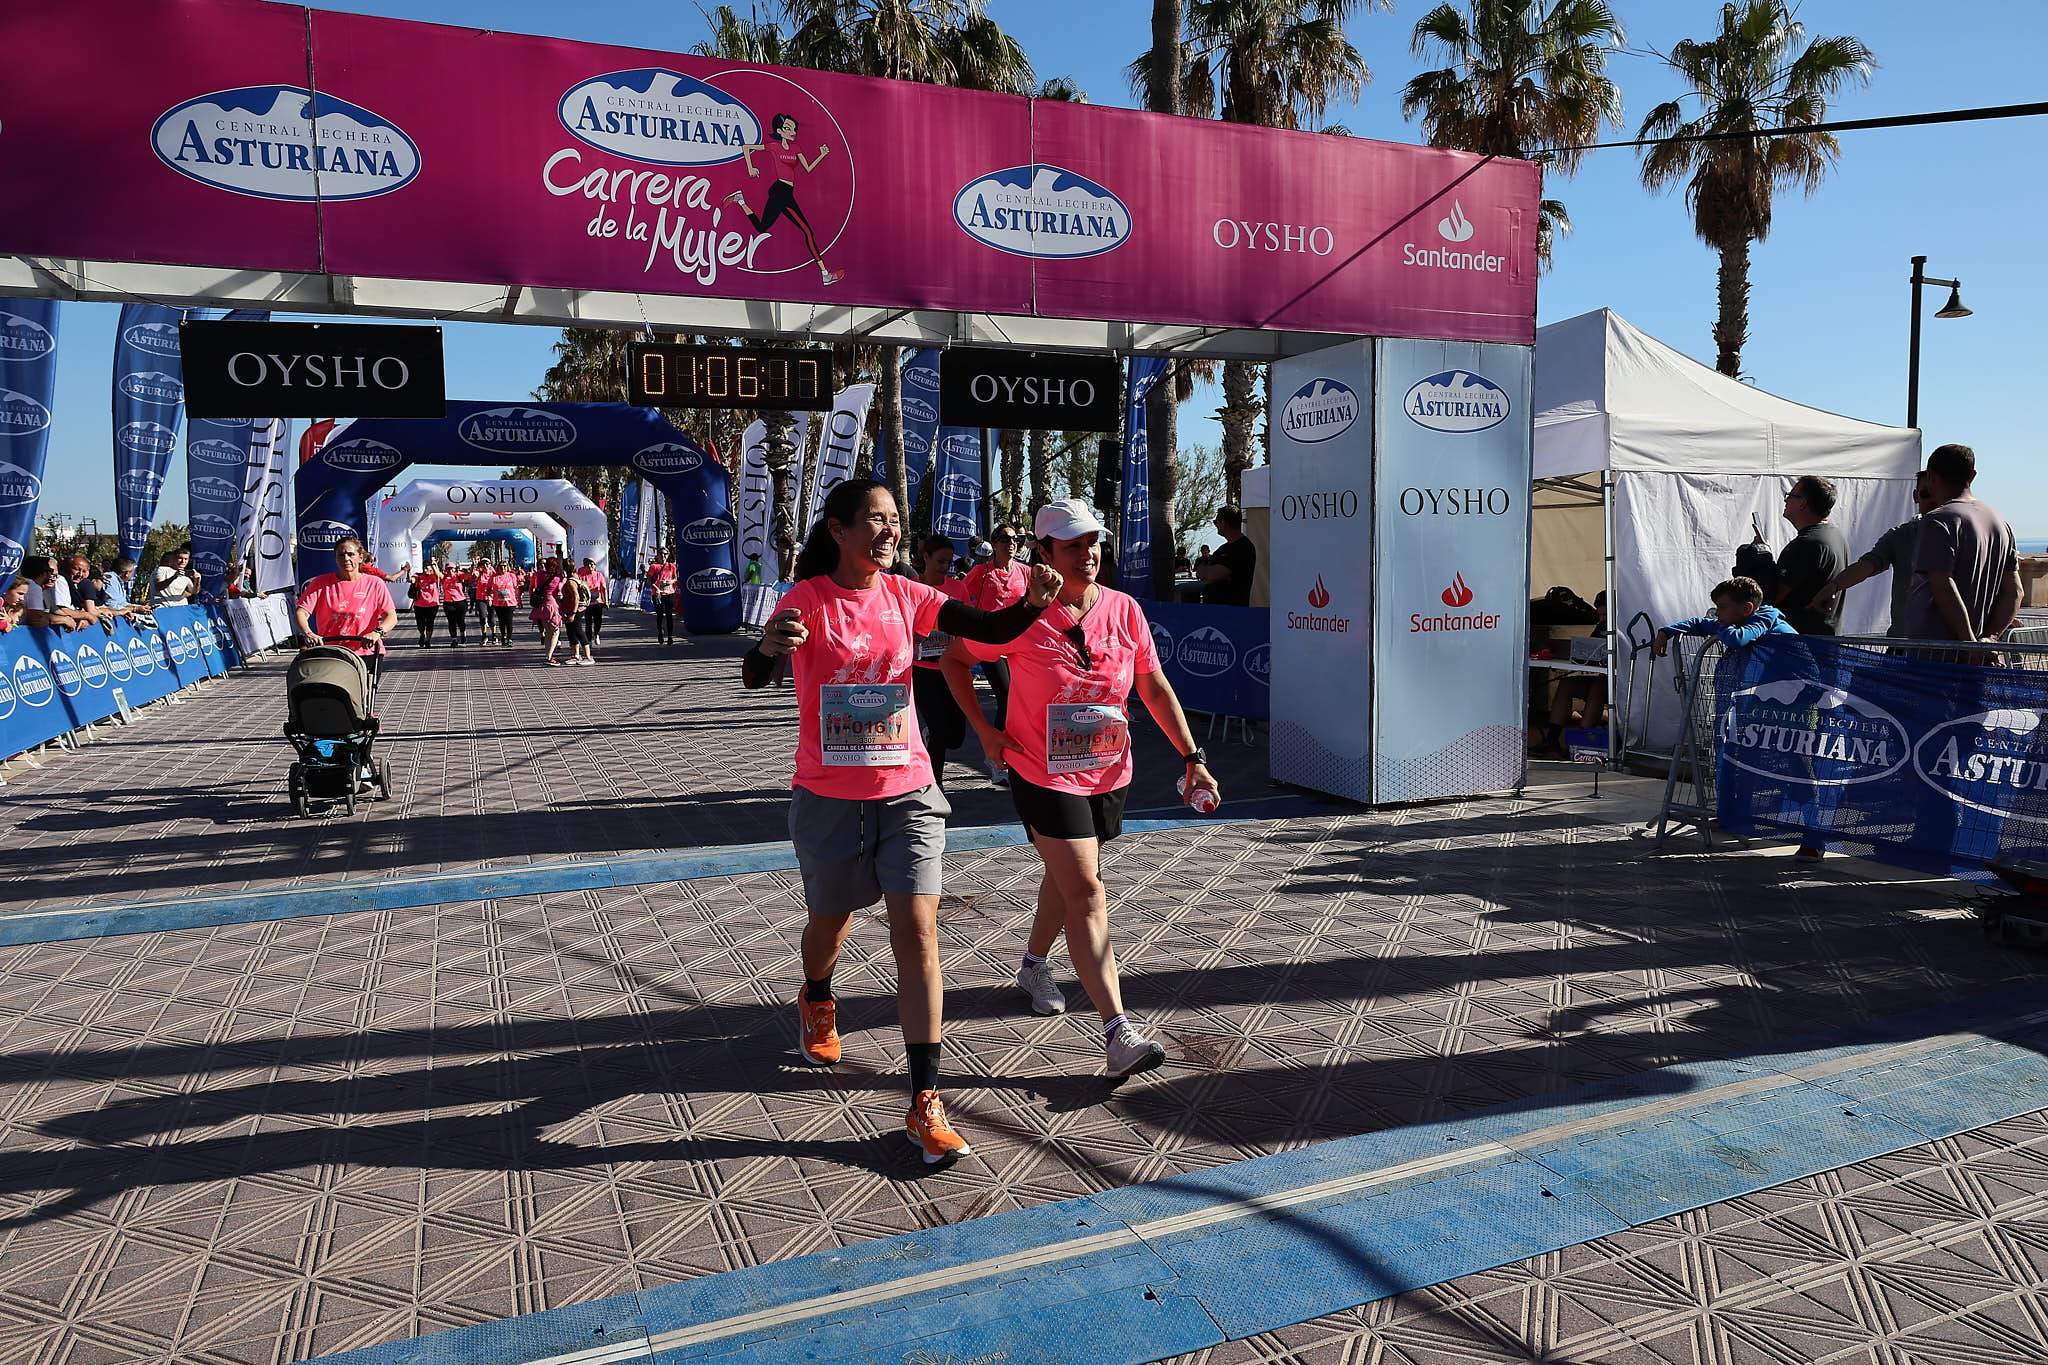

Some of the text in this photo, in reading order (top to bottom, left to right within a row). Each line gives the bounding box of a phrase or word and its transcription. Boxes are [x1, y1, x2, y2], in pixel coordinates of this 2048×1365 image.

[576, 95, 745, 147] ASTURIANA
[607, 96, 741, 120] CENTRAL LECHERA
[215, 120, 300, 137] CENTRAL
[174, 119, 402, 177] ASTURIANA
[543, 148, 712, 210] Carrera
[968, 193, 1119, 238] ASTURIANA
[996, 193, 1113, 212] CENTRAL LECHERA
[587, 205, 648, 241] de la
[644, 207, 772, 285] Mujer
[1213, 218, 1335, 256] OYSHO
[1403, 243, 1506, 273] Santander
[227, 351, 410, 391] OYSHO
[643, 353, 818, 398] 01:06:17
[970, 374, 1095, 407] OYSHO
[1286, 404, 1353, 431] ASTURIANA
[1411, 391, 1503, 418] ASTURIANA
[468, 420, 569, 442] ASTURIANA
[193, 444, 242, 462] ASTURIANA
[328, 450, 396, 464] ASTURIANA
[640, 455, 698, 466] ASTURIANA
[446, 486, 539, 504] OYSHO
[1281, 490, 1358, 521] OYSHO
[1400, 487, 1510, 516] OYSHO
[391, 505, 420, 513] OYSHO
[1287, 611, 1351, 633] Santander
[1410, 612, 1501, 633] Santander
[1181, 643, 1229, 667] ASTURIANA
